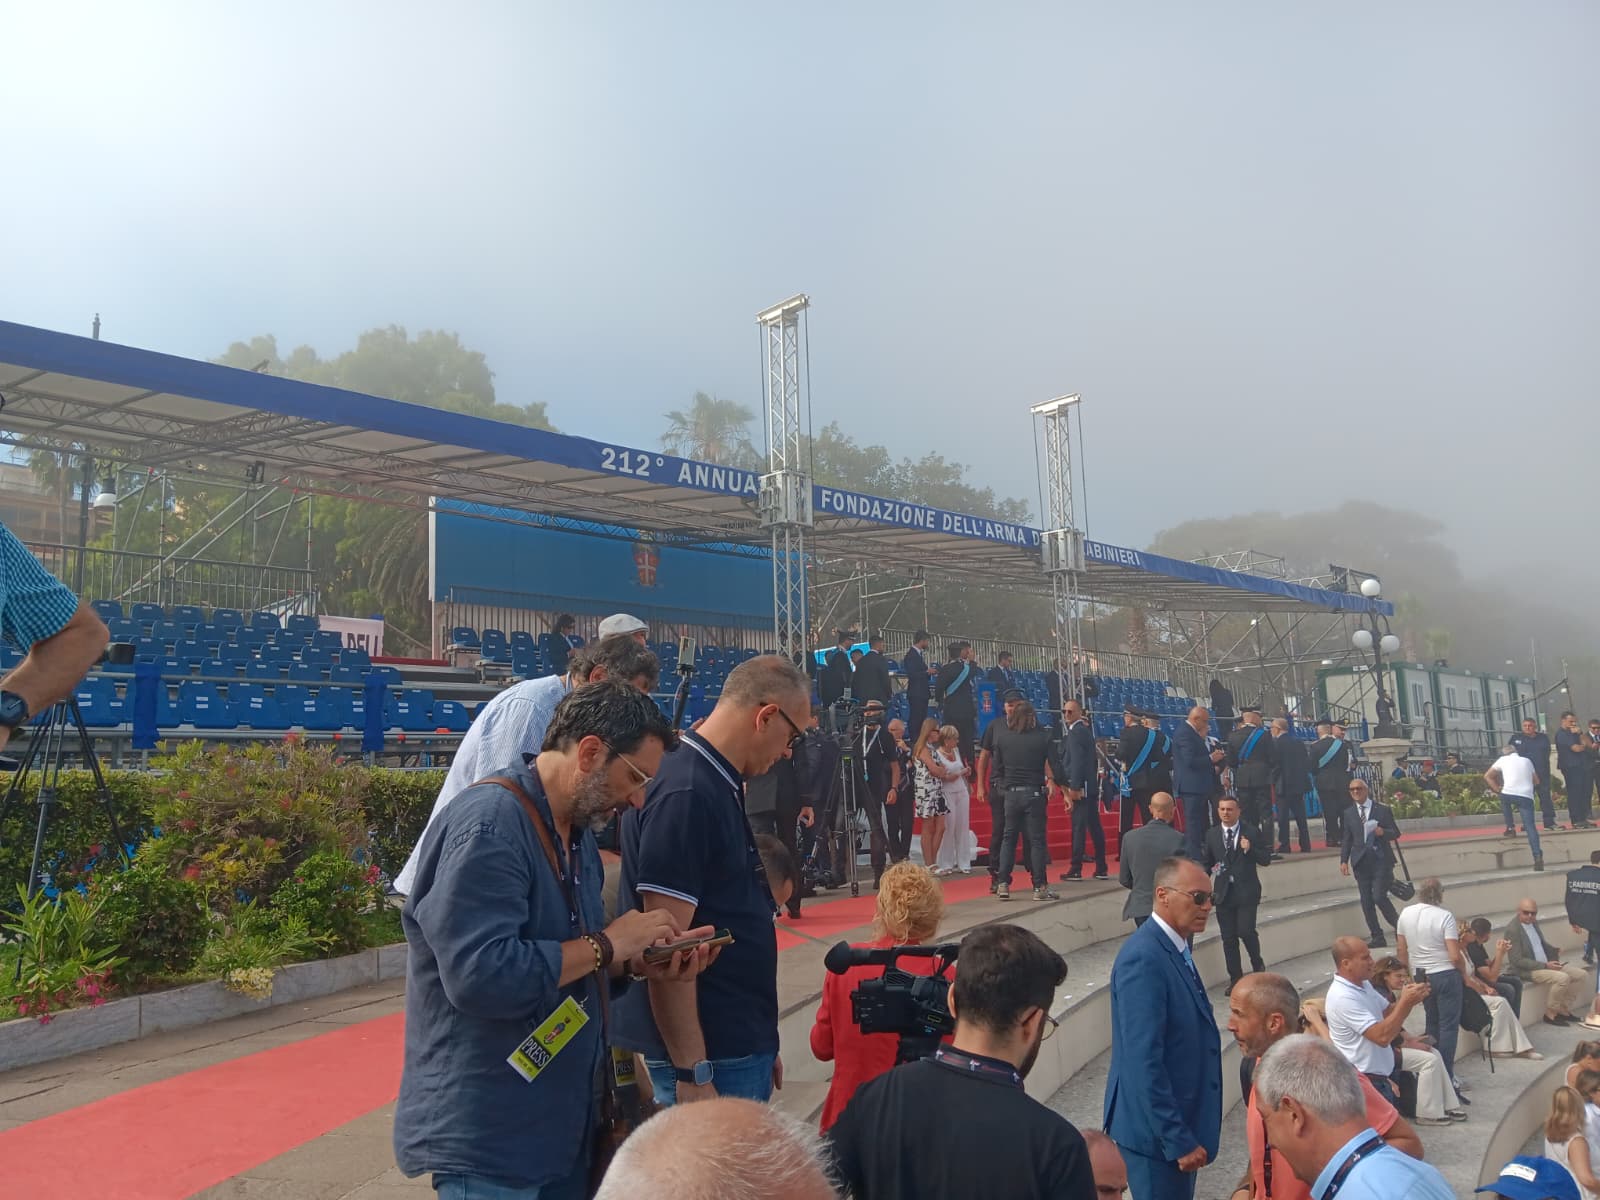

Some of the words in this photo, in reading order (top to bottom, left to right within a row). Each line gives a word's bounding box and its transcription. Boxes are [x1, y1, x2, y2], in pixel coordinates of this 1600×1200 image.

[601, 447, 664, 477] 212°
[678, 462, 758, 494] ANNUA
[821, 488, 935, 529] FONDAZIONE
[943, 514, 1026, 545] DELL'ARMA
[1085, 543, 1141, 566] ABINIERI
[521, 1038, 550, 1067] PRESS
